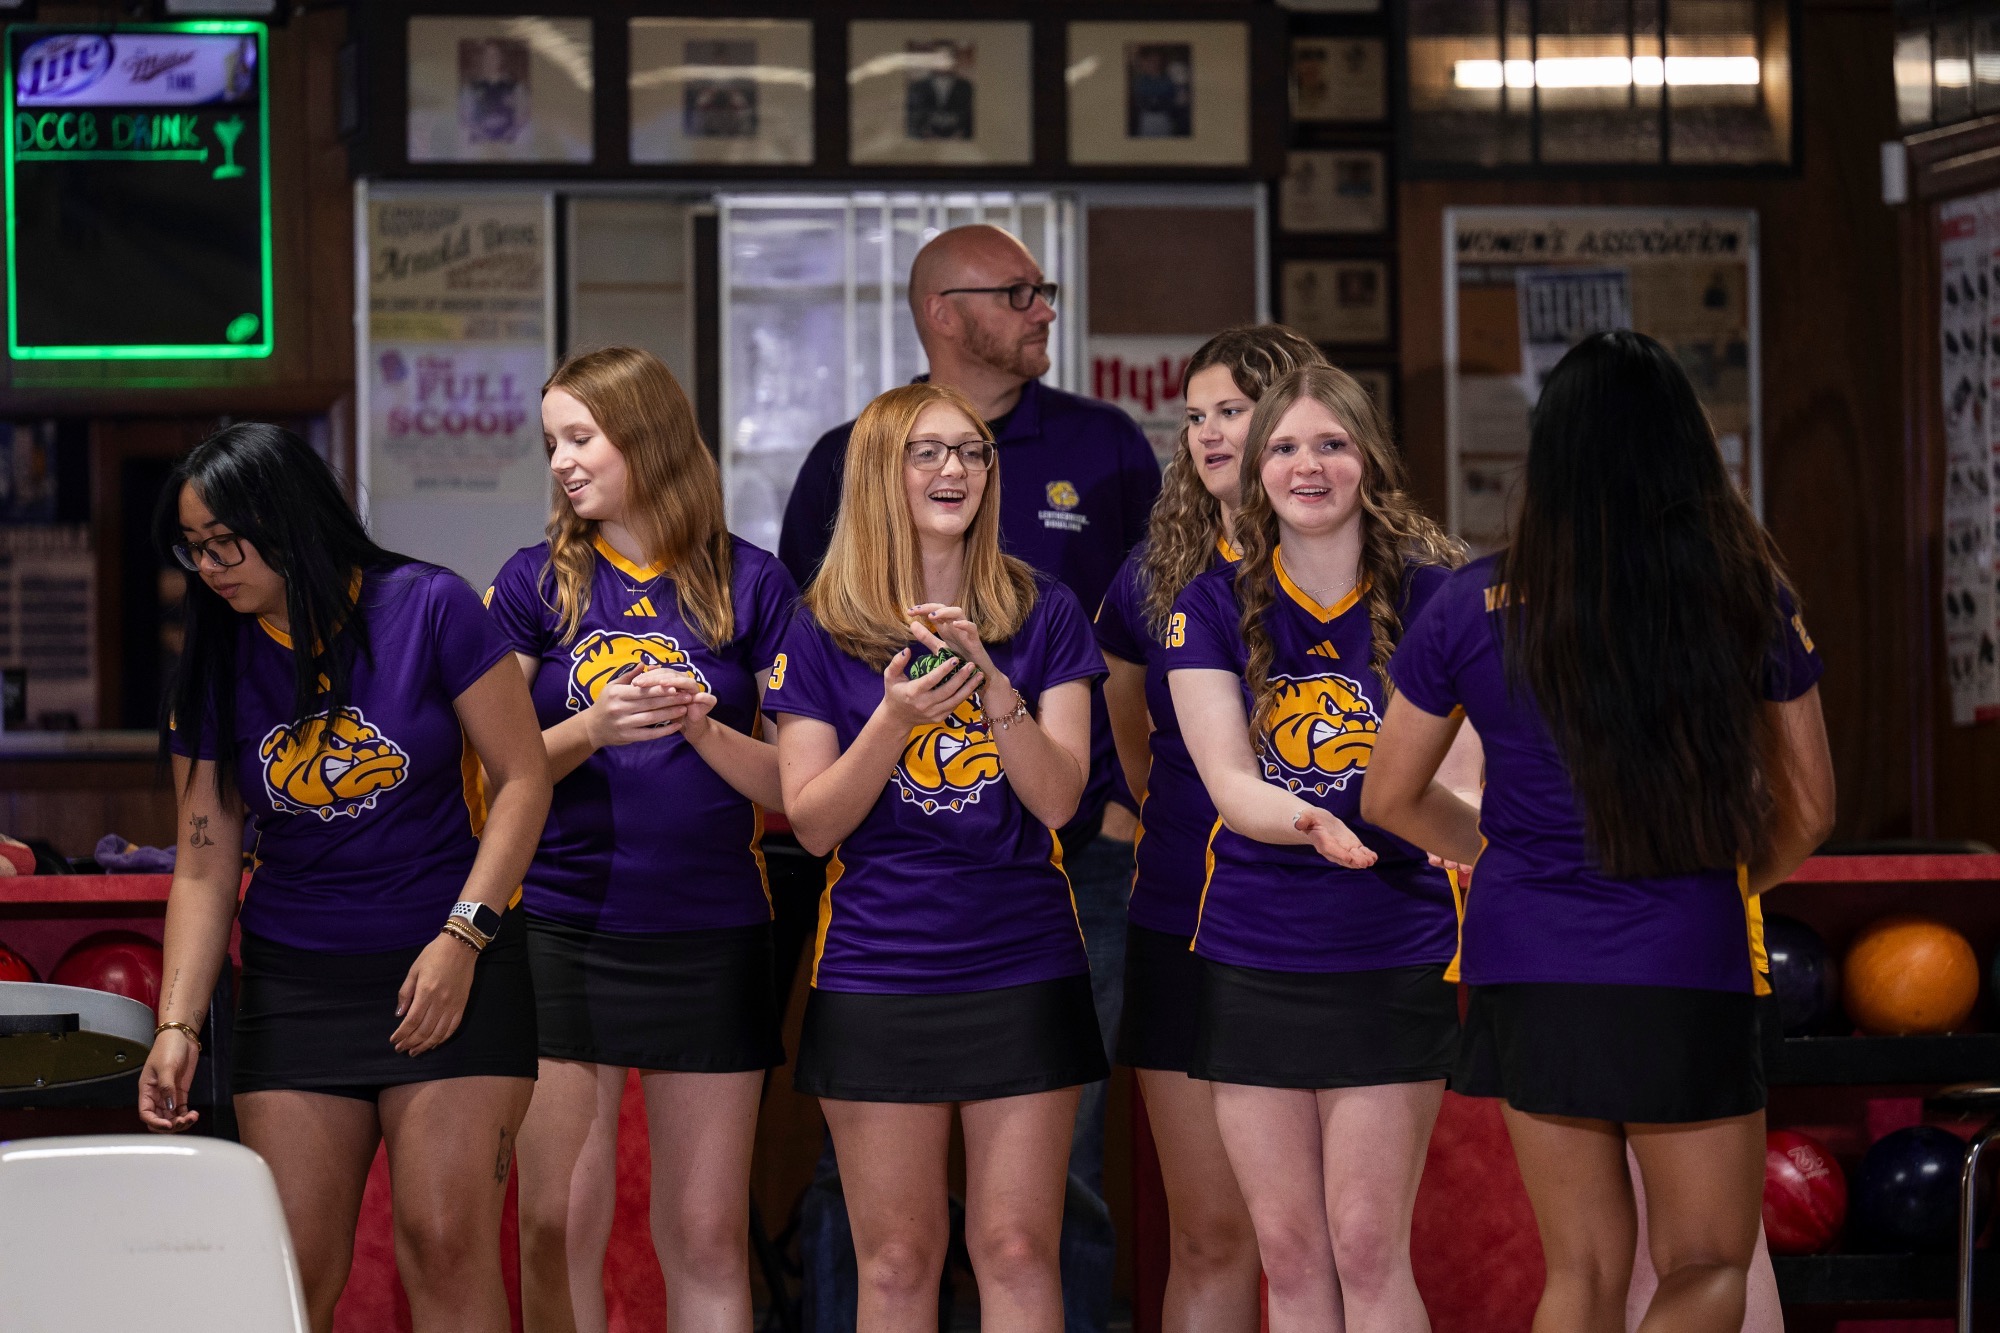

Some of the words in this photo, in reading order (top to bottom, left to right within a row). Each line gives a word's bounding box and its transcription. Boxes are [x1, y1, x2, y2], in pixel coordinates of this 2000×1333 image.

[111, 113, 200, 149] DRINK
[1576, 226, 1741, 254] ASSOCIATION
[416, 372, 526, 402] FULL
[387, 407, 527, 438] SCOOP
[768, 653, 788, 690] 3
